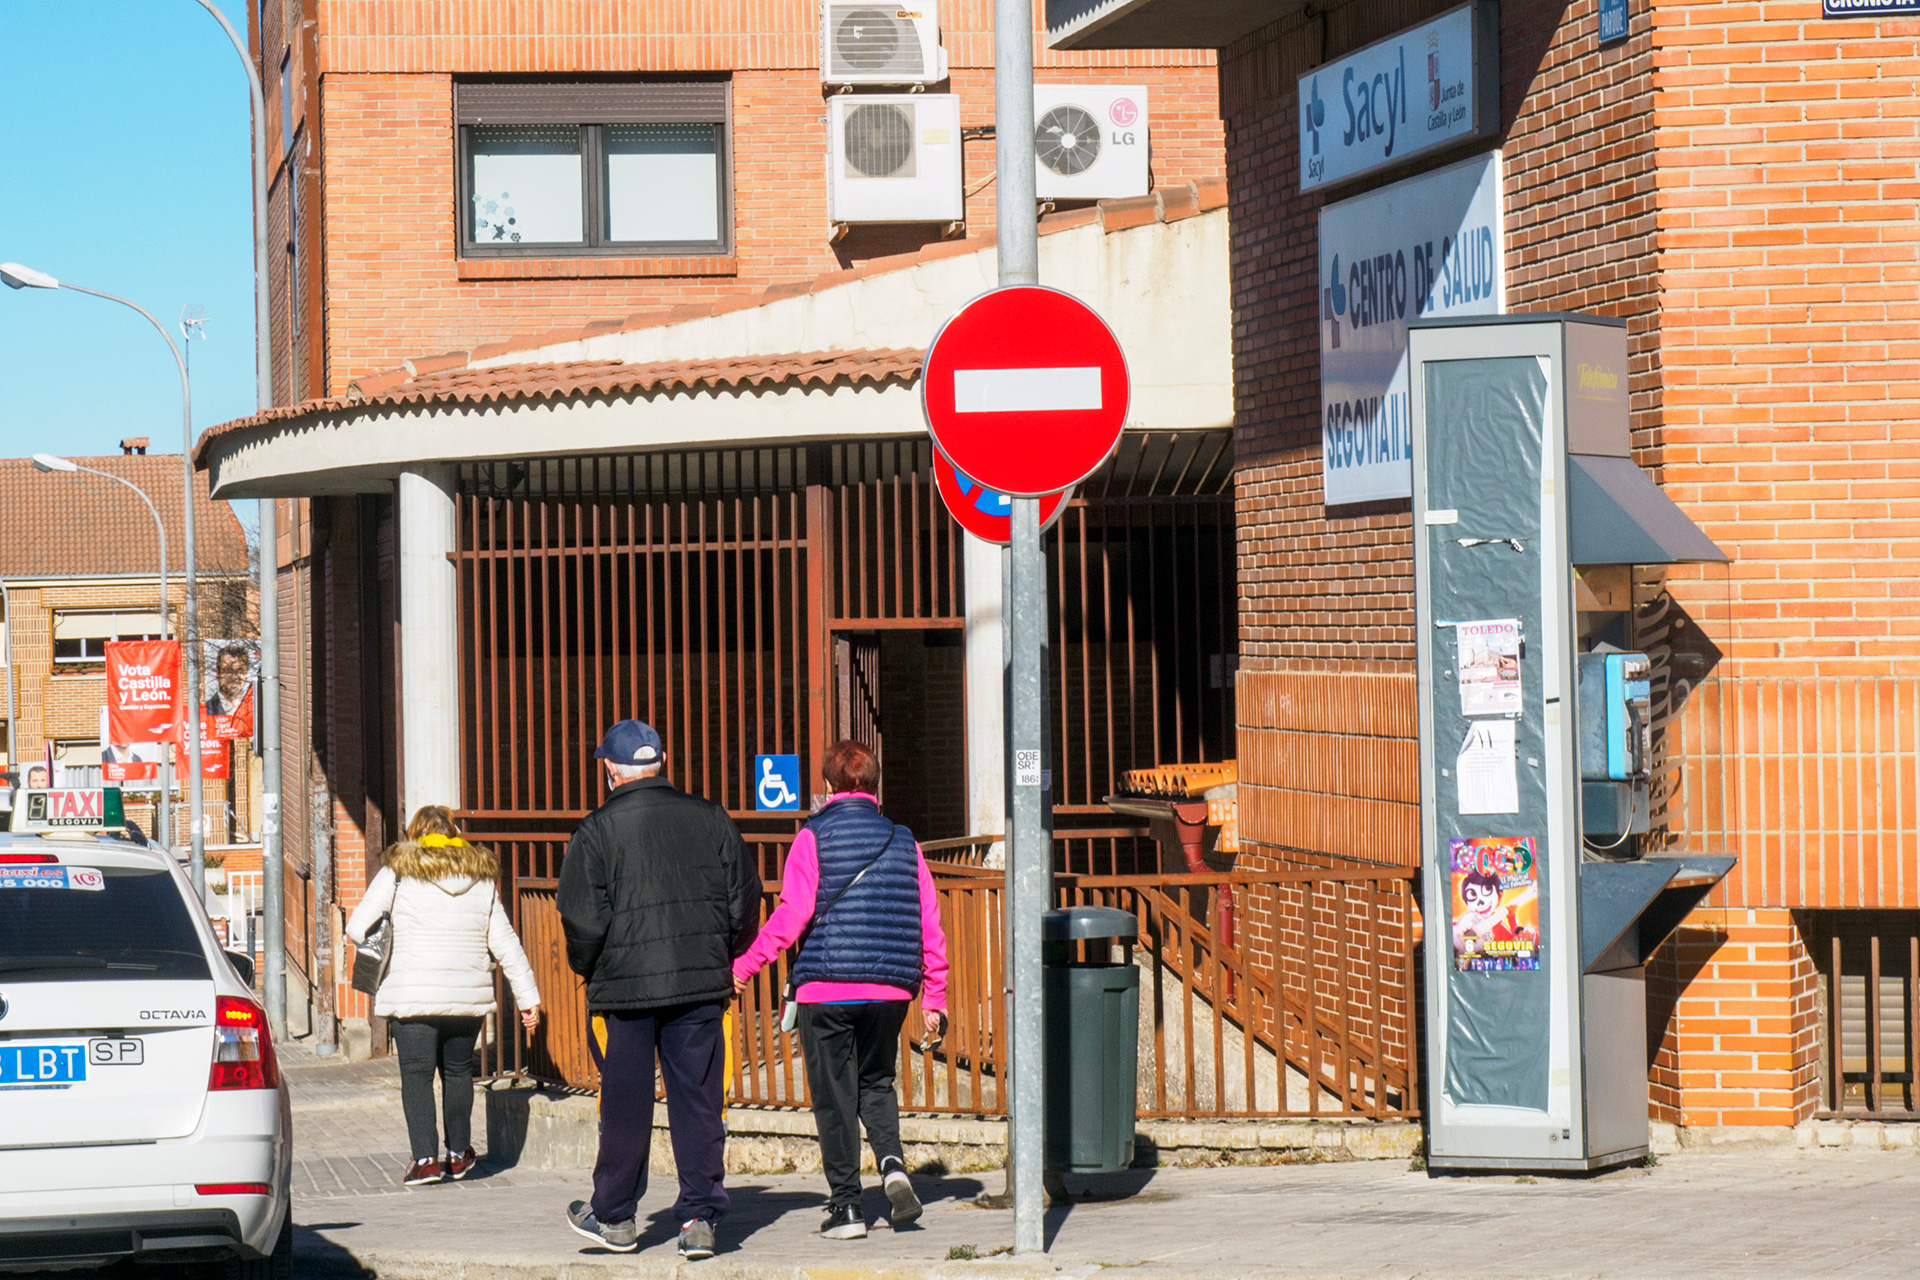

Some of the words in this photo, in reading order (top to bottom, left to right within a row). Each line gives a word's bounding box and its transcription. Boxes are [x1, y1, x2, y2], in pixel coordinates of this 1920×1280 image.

[1441, 85, 1456, 103] Junta
[1457, 80, 1464, 96] de
[1343, 45, 1406, 158] Sacyl
[1428, 111, 1447, 131] Castilla
[1112, 132, 1135, 145] LG
[1308, 155, 1325, 182] Sacyl
[1349, 249, 1407, 329] CENTRO
[1414, 241, 1434, 315] DE
[1443, 225, 1493, 309] SALUD
[1327, 395, 1390, 470] SEGOVIA
[1391, 393, 1400, 461] II
[1462, 624, 1514, 636] TOLEDO
[118, 664, 151, 676] Vota
[118, 676, 171, 690] Castilla
[119, 692, 128, 704] y
[132, 688, 171, 701] León.
[1018, 752, 1038, 760] OBE
[48, 791, 103, 817] TAXI
[0, 879, 17, 888] 5
[23, 879, 64, 888] 000
[1465, 939, 1474, 953] 6
[1483, 940, 1534, 951] SEGOVIA
[96, 1042, 137, 1062] SP
[16, 1048, 80, 1080] LBT
